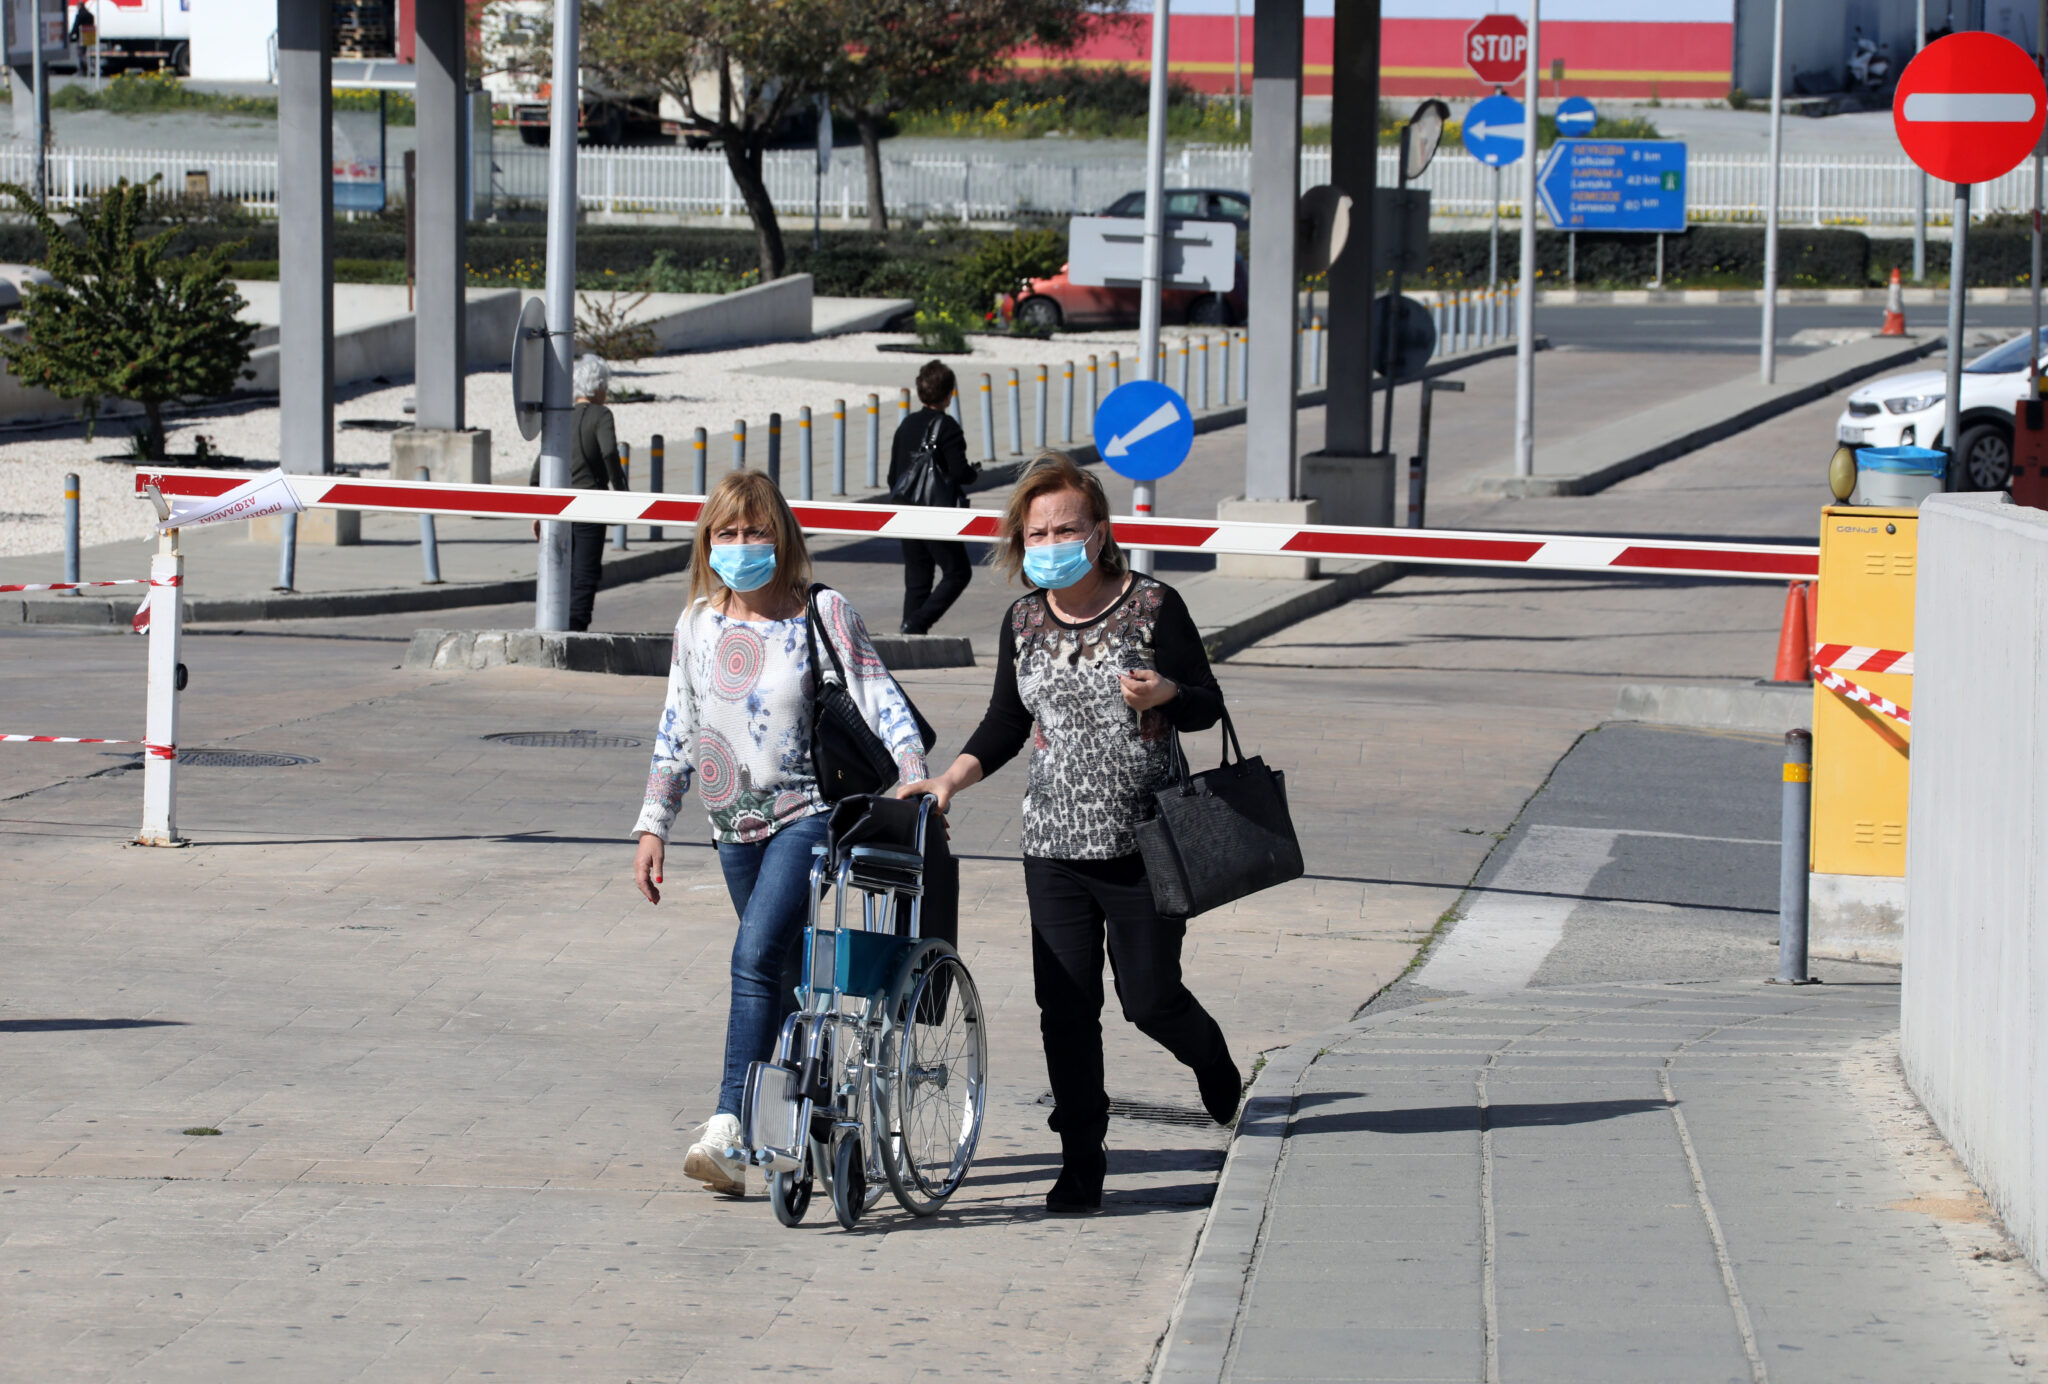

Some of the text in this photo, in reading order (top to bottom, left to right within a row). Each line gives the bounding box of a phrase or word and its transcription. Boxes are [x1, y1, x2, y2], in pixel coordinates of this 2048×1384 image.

[1471, 35, 1527, 62] STOP
[1643, 151, 1661, 161] km
[1643, 174, 1660, 185] km
[1642, 197, 1660, 208] km
